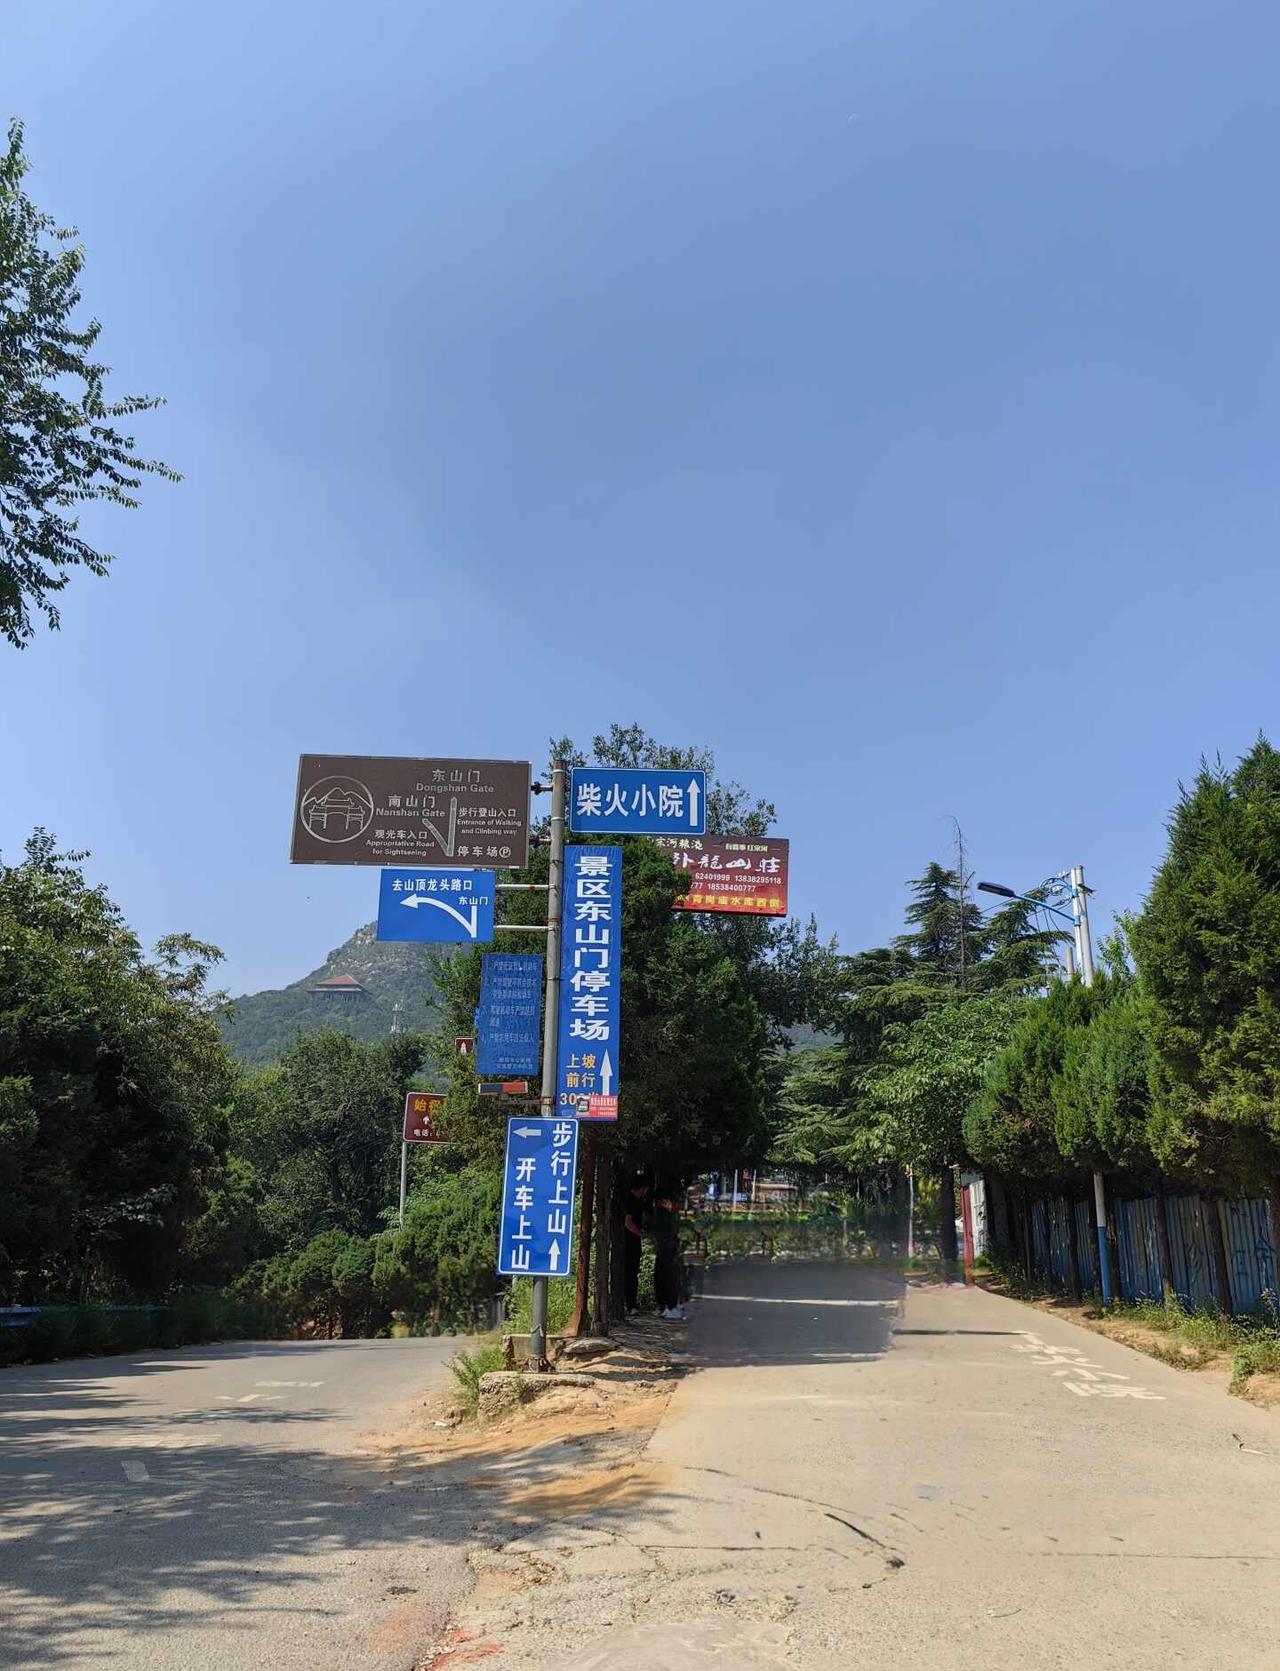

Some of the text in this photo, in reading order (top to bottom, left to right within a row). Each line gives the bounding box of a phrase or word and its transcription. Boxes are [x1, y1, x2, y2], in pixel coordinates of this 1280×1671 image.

[432, 769, 481, 783] 东山门
[416, 783, 495, 794] Dongshan Gate
[388, 795, 436, 808] 南山门
[577, 783, 684, 817] 柴火小院
[376, 808, 446, 818] Nanshan Gate
[459, 807, 516, 818] 步行登山入口
[495, 819, 522, 827] Walking
[374, 829, 428, 839] 观光车入口
[384, 848, 427, 857] Sightseeing
[457, 846, 498, 858] 停车场
[392, 878, 473, 892] 去山顶龙头路口
[458, 896, 489, 906] 东山门
[570, 855, 613, 1042] 景区东山门停车场
[566, 1053, 597, 1069] 上坡
[566, 1072, 596, 1088] 前行
[548, 1123, 574, 1235] 步行上山
[511, 1157, 537, 1270] 开车上山
